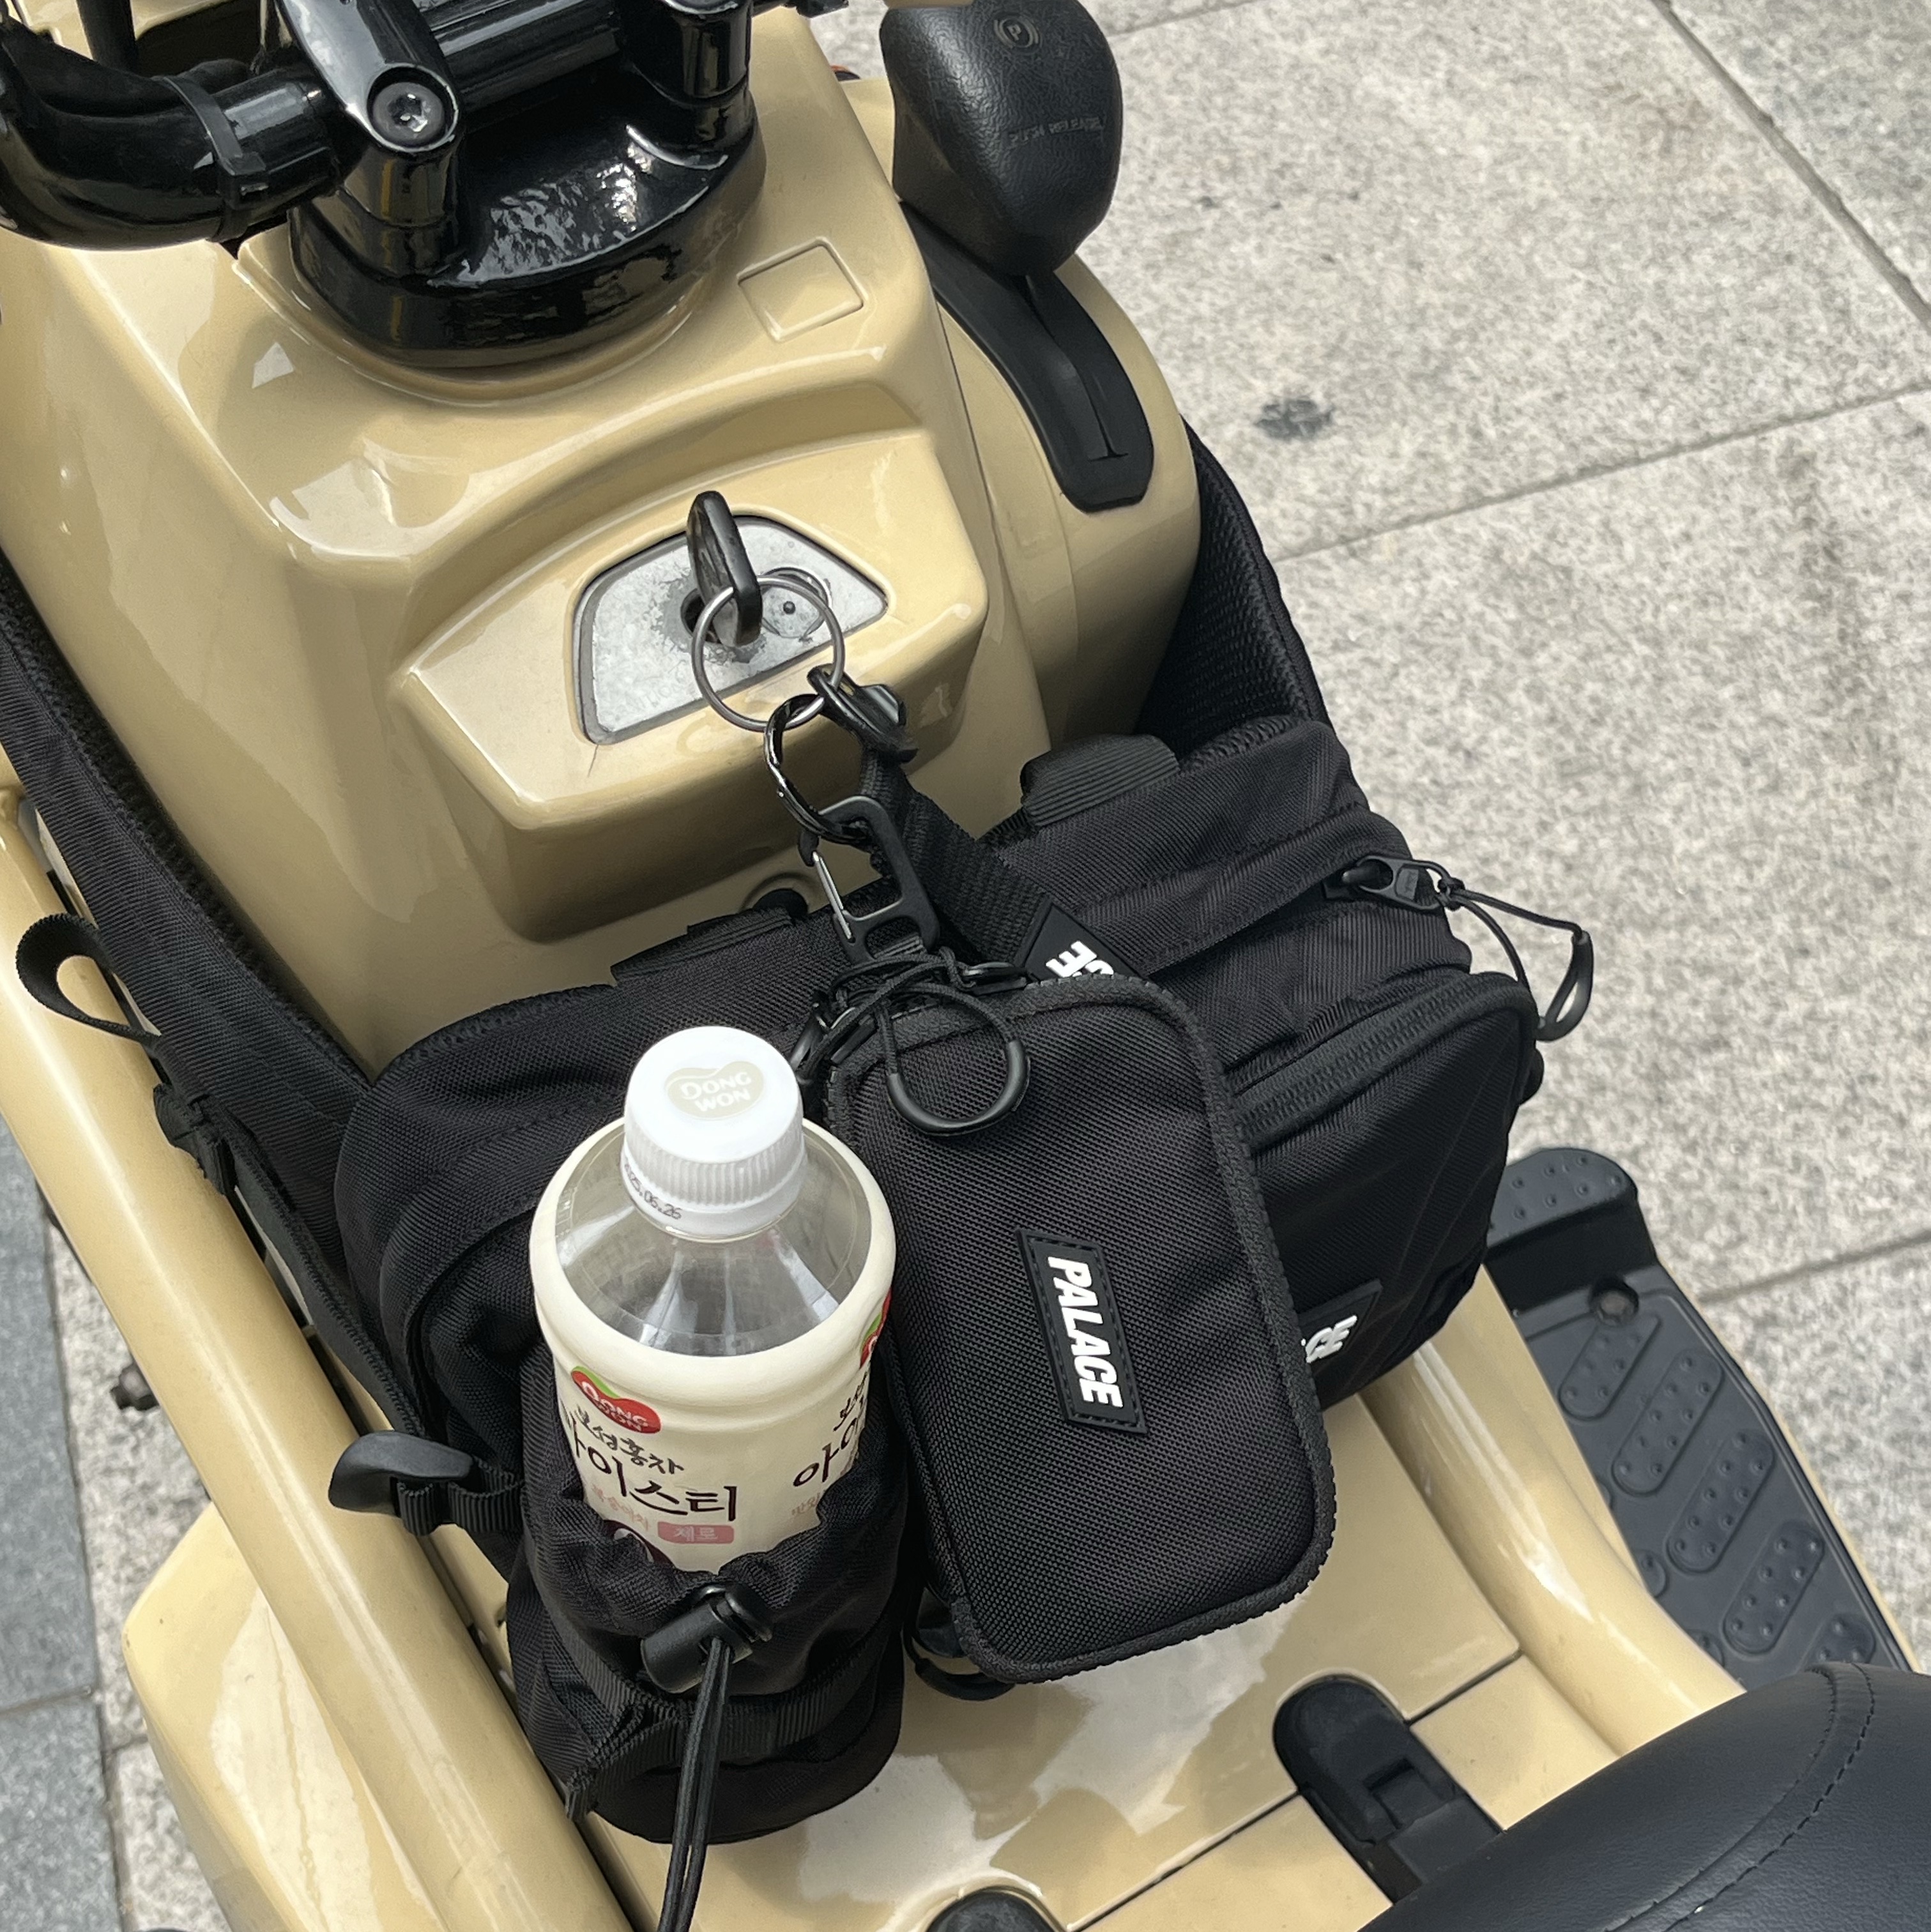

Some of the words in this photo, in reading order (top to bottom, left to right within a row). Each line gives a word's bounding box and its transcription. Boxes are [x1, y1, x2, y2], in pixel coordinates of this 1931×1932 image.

[680, 1072, 752, 1100] DONG
[694, 1090, 751, 1113] WON
[1047, 1256, 1124, 1409] PALACE
[582, 1381, 649, 1427] DONG
[673, 1525, 719, 1542] 제로
